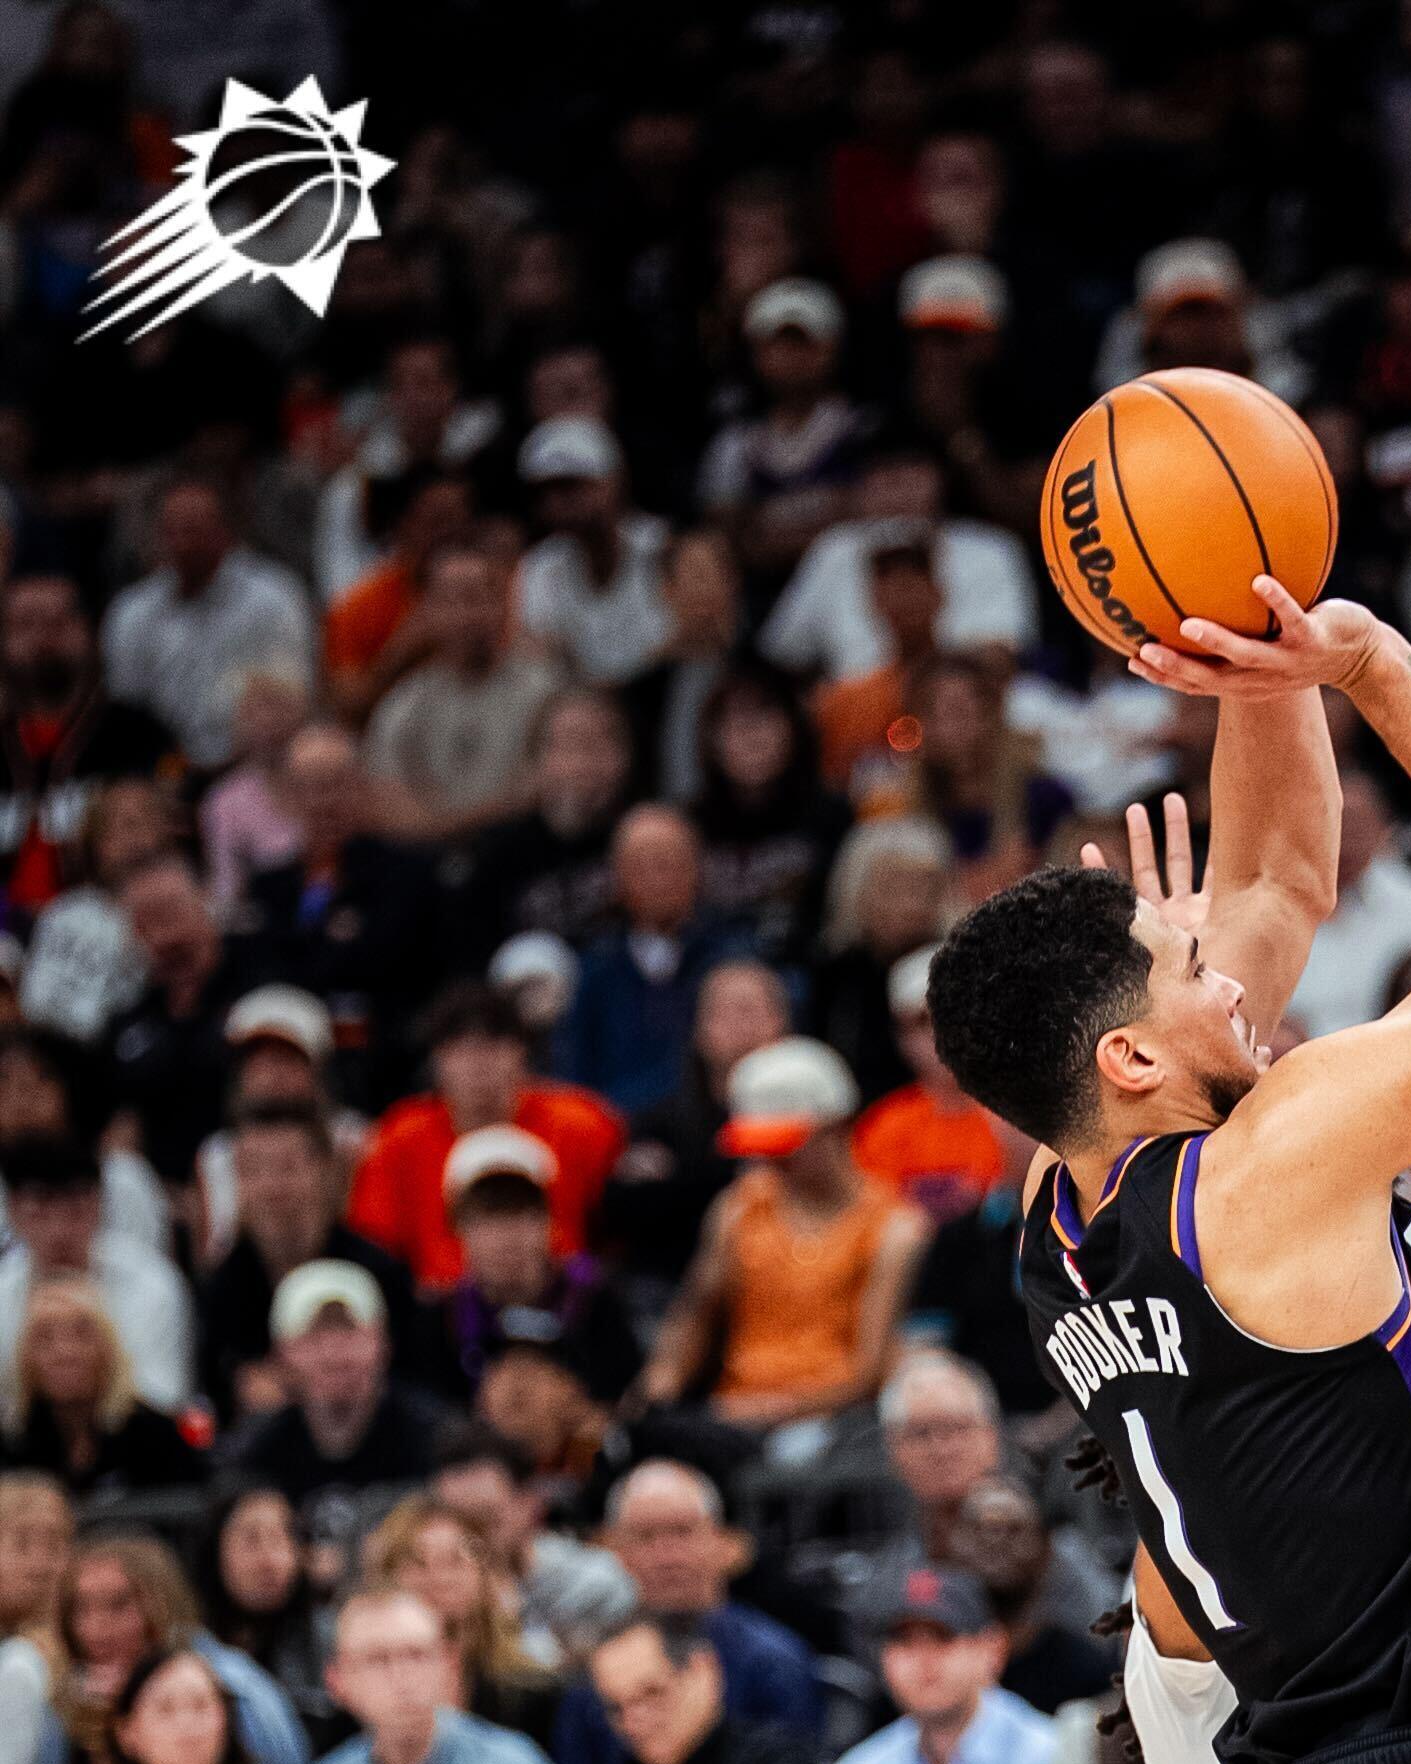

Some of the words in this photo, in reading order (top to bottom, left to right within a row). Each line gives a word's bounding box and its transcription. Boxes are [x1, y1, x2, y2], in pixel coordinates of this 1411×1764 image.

[1061, 459, 1161, 646] Wilson
[1046, 1297, 1189, 1411] BOOKER
[1121, 1408, 1240, 1630] 1
